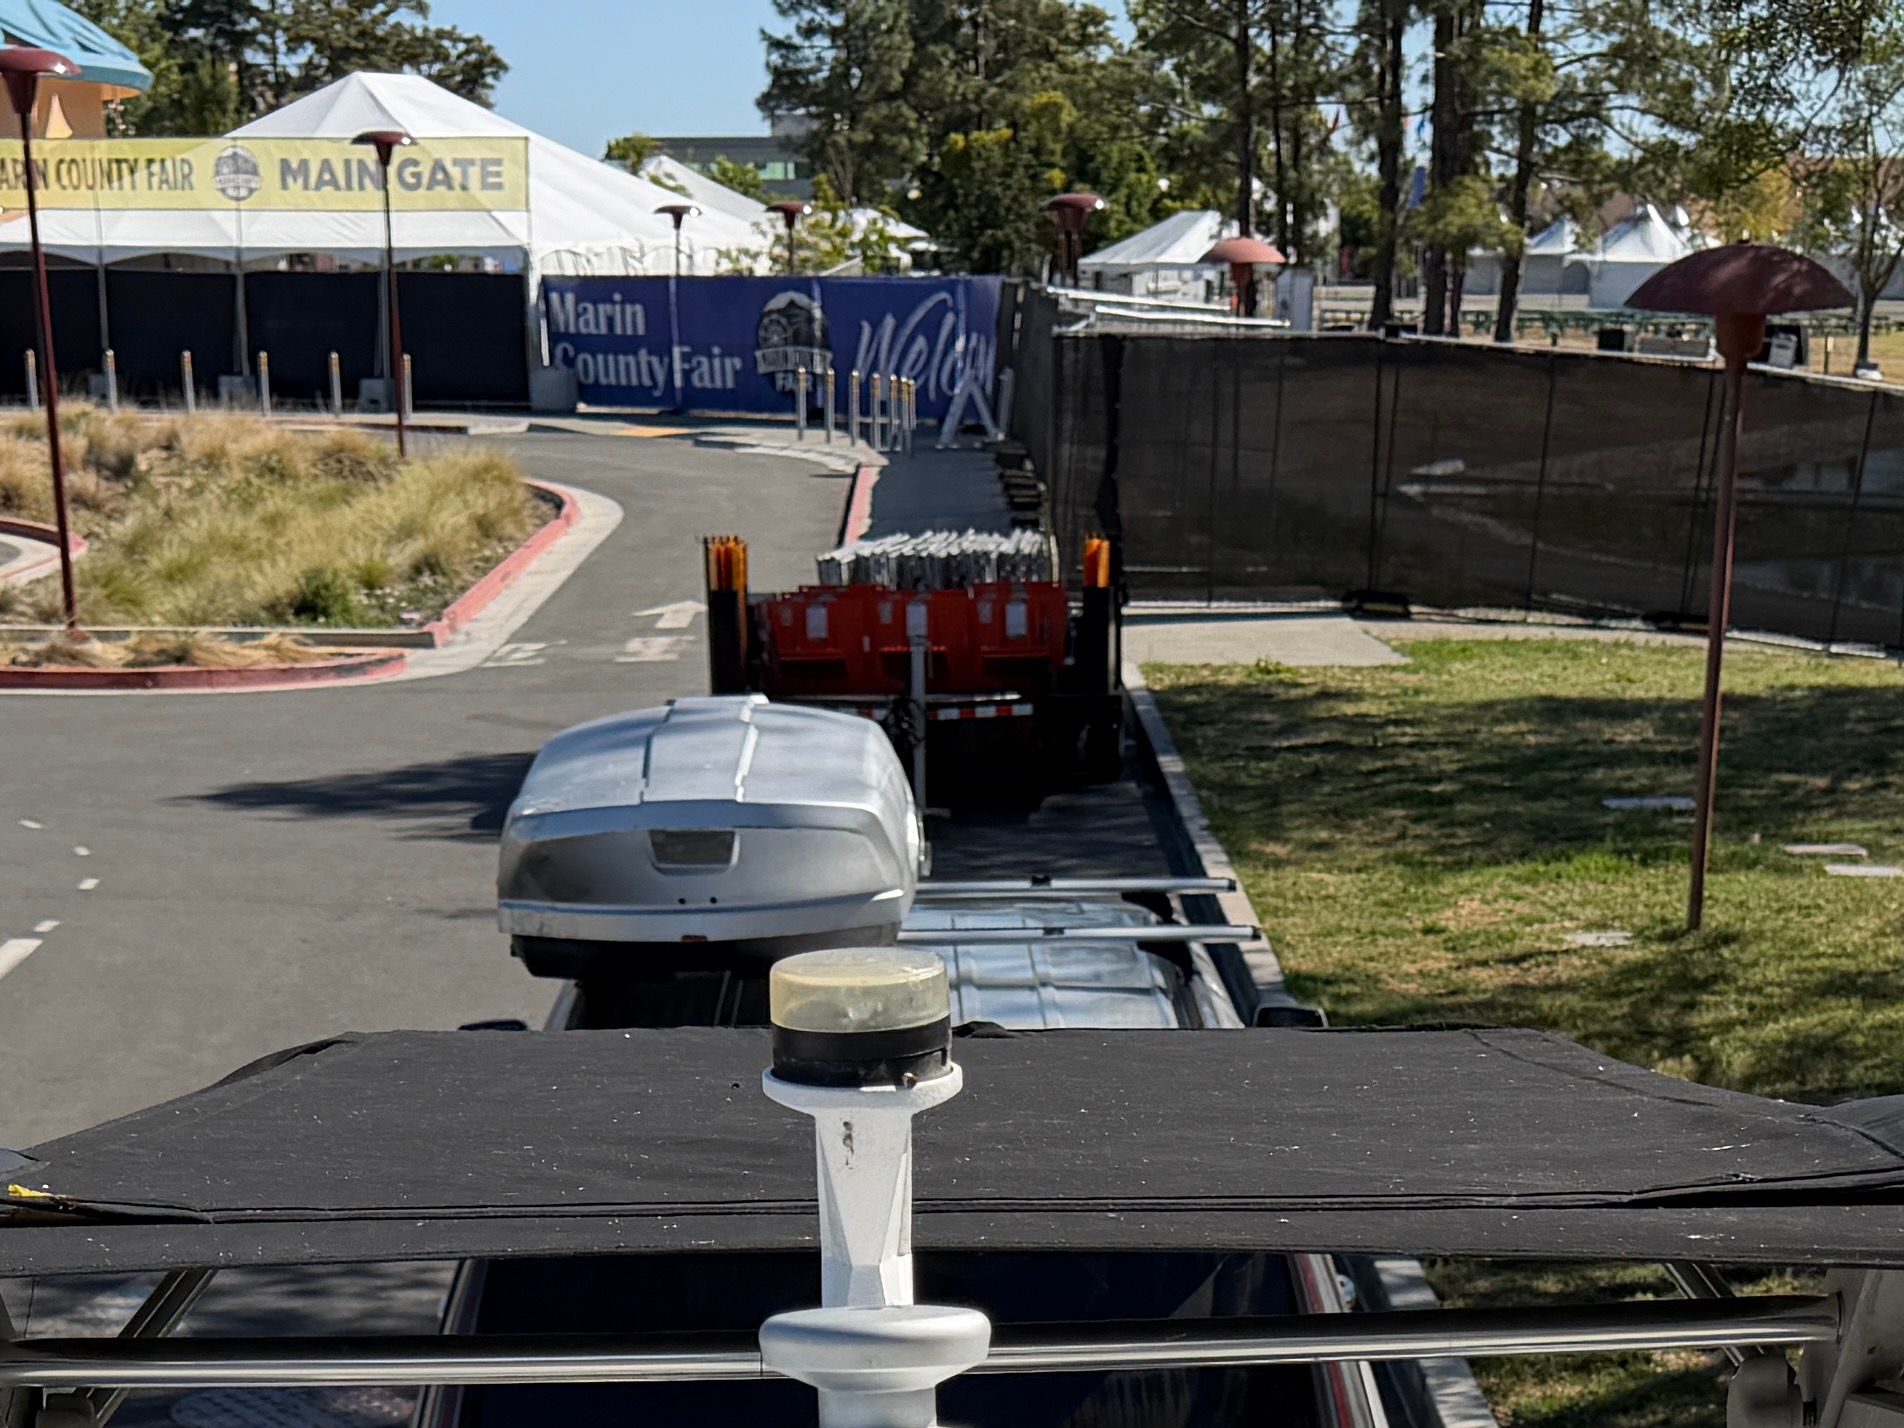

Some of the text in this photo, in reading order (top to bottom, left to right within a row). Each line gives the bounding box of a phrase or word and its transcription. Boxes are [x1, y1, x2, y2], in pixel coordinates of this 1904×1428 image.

[55, 157, 138, 191] COUNTY
[146, 157, 194, 191] FAIR
[279, 157, 384, 191] MAIN
[396, 156, 505, 191] GATE
[548, 290, 647, 336] Marin
[555, 341, 670, 397] County
[671, 344, 744, 390] Fair
